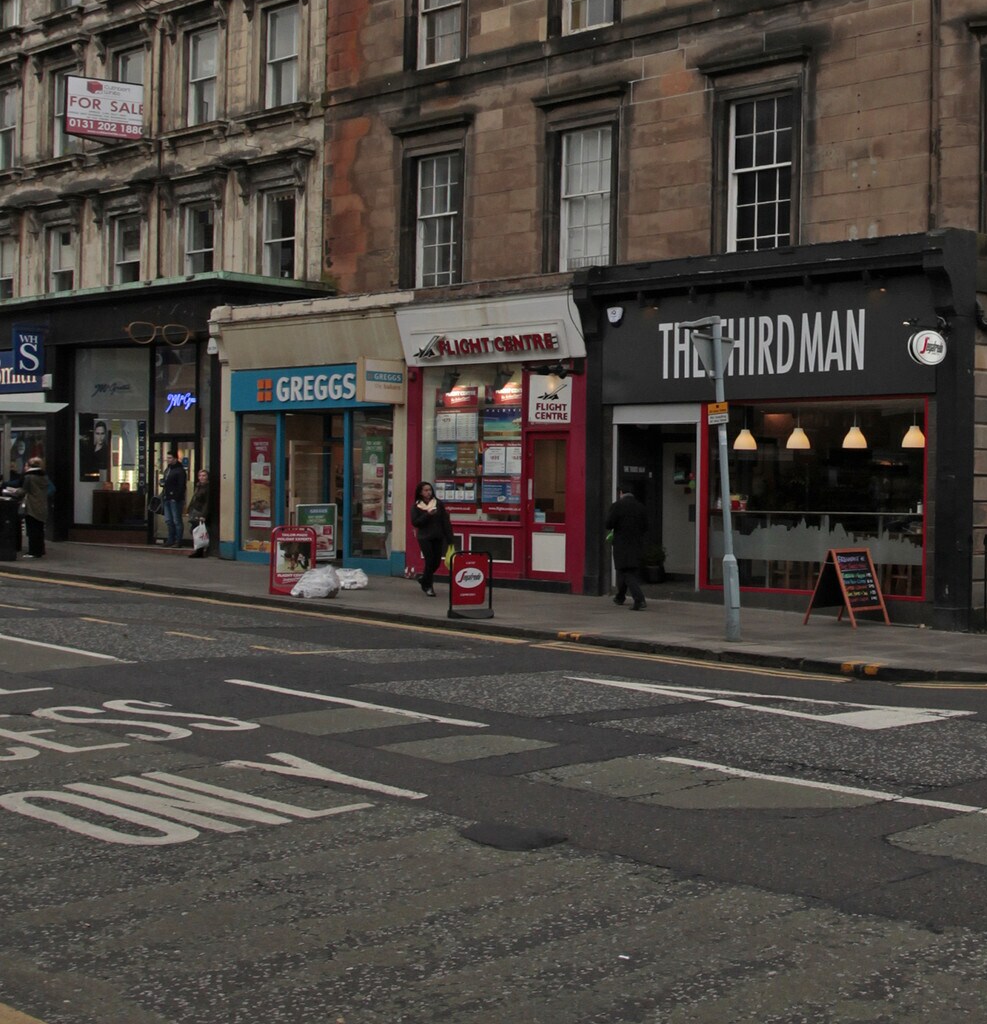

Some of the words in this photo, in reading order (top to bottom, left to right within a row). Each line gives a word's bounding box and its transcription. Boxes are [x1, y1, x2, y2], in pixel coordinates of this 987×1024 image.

[69, 95, 102, 110] FOR
[110, 100, 144, 115] SALE
[69, 118, 94, 128] 0131
[97, 122, 117, 132] 202
[438, 336, 490, 356] FLIGHT
[493, 332, 554, 353] CENTRE
[374, 372, 402, 382] GREGGS
[276, 372, 356, 403] GREGGS
[536, 402, 567, 413] FLIGHT
[535, 411, 568, 422] CENTRE
[0, 751, 429, 846] ONLY
